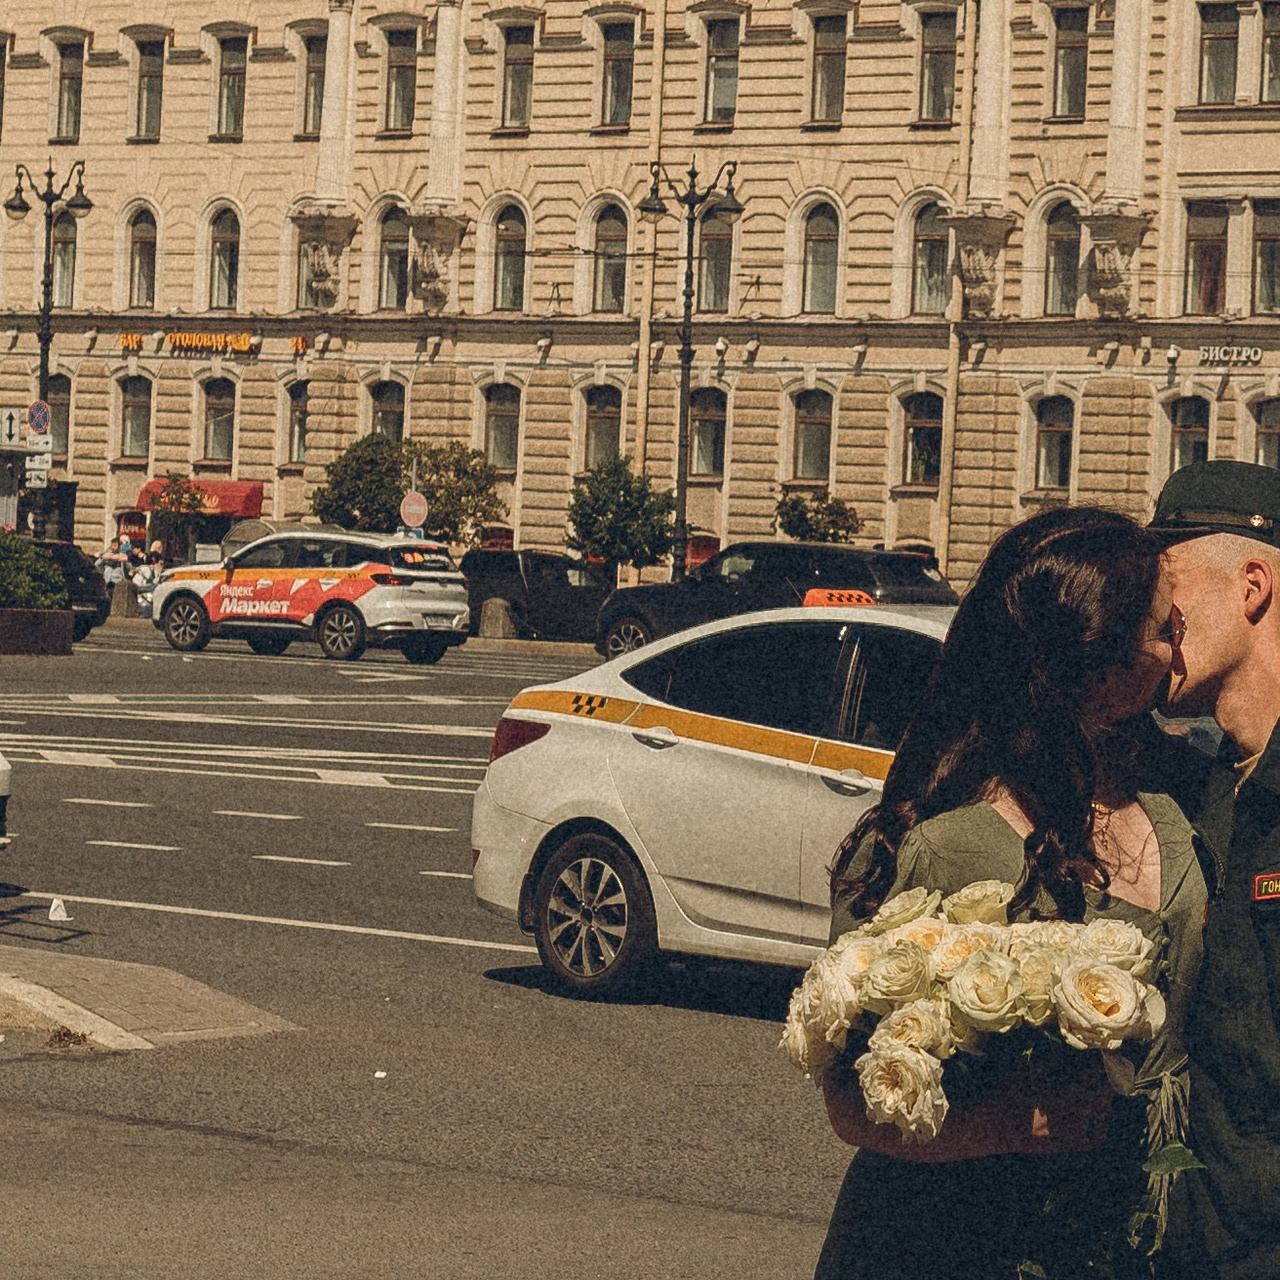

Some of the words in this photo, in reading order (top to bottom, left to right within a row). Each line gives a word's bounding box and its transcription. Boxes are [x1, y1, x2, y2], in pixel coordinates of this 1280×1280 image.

[120, 333, 142, 349] БАР
[167, 332, 225, 349] СТОЛОВАЯ
[1199, 346, 1262, 361] БИСТРО
[220, 584, 254, 598] Яндекс
[220, 598, 290, 616] Маркет
